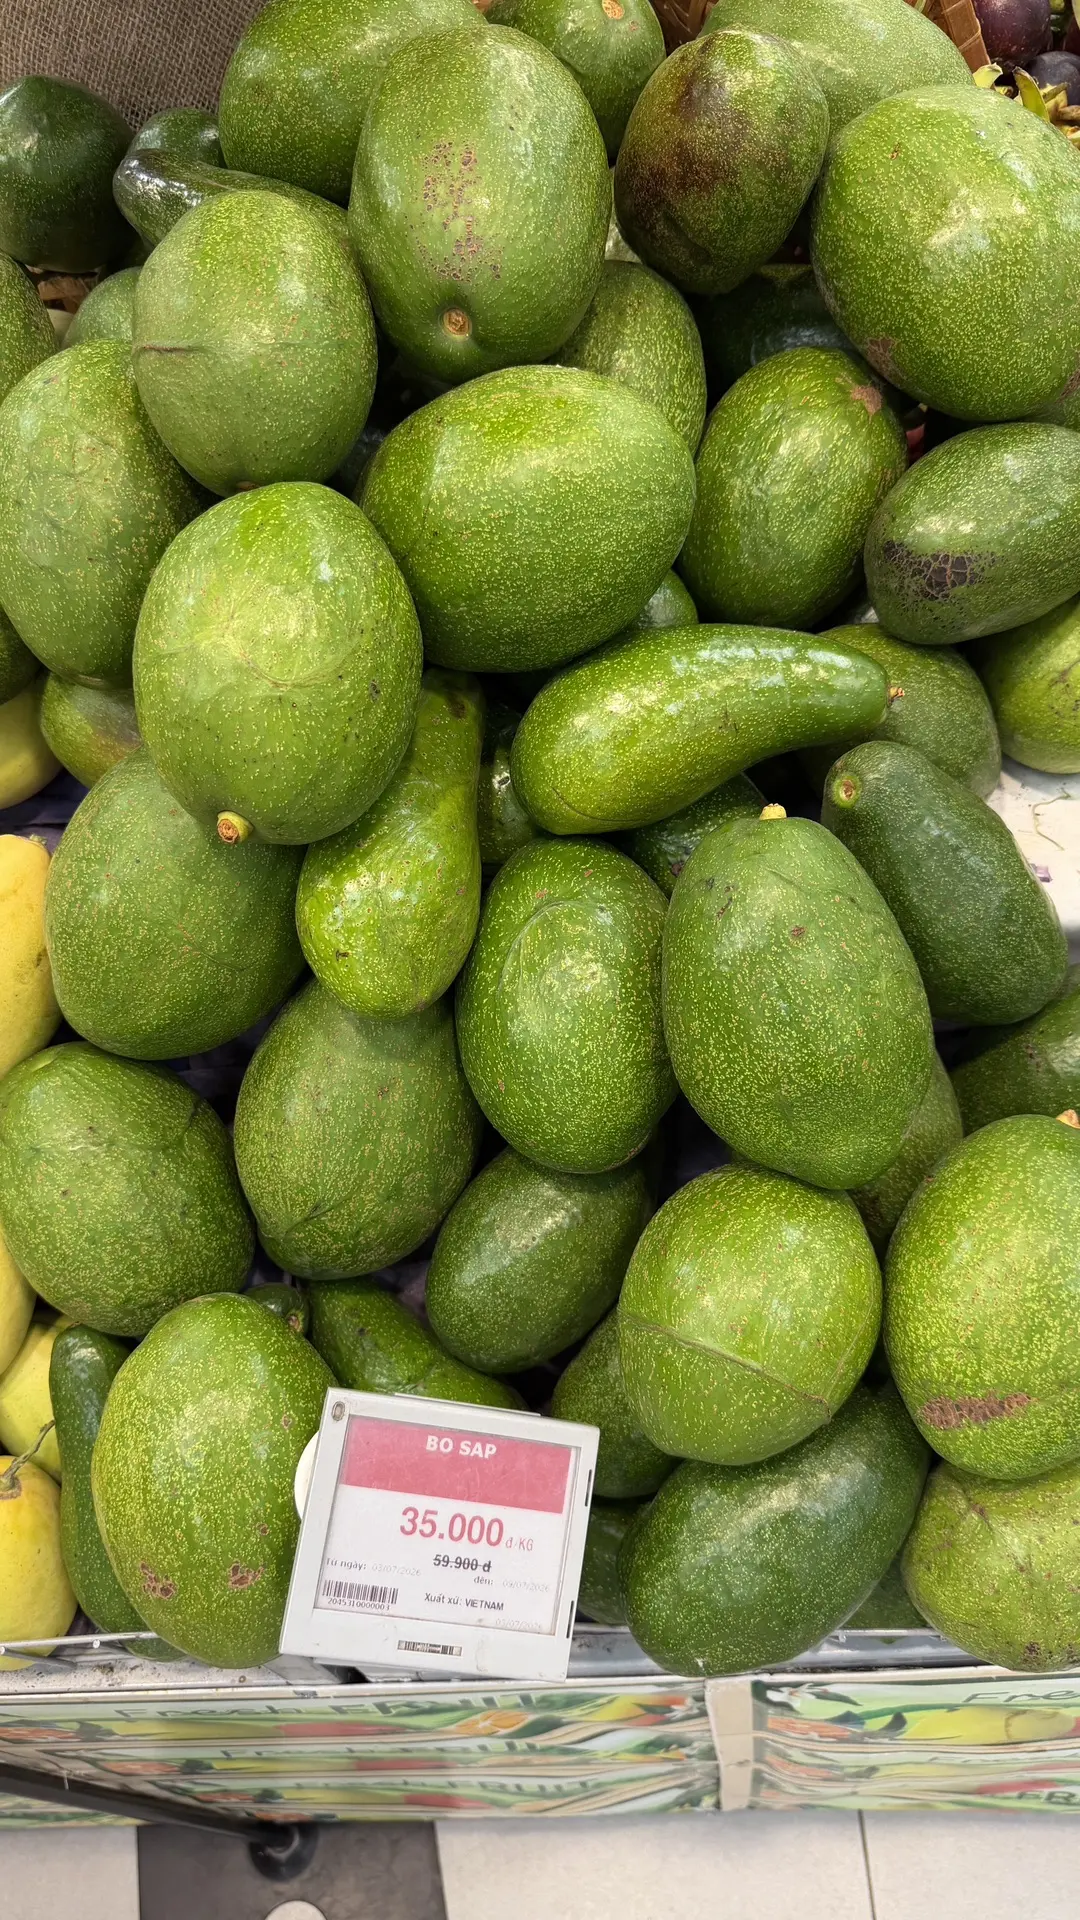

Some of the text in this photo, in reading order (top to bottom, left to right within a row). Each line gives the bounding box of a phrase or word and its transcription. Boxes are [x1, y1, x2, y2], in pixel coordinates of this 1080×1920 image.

[425, 1434, 497, 1460] BO SAP
[400, 1506, 504, 1547] 35.000
[340, 1560, 367, 1571] ngày:
[432, 1553, 479, 1572] 59.900
[424, 1592, 504, 1611] Xuất xứ: VIETNAM
